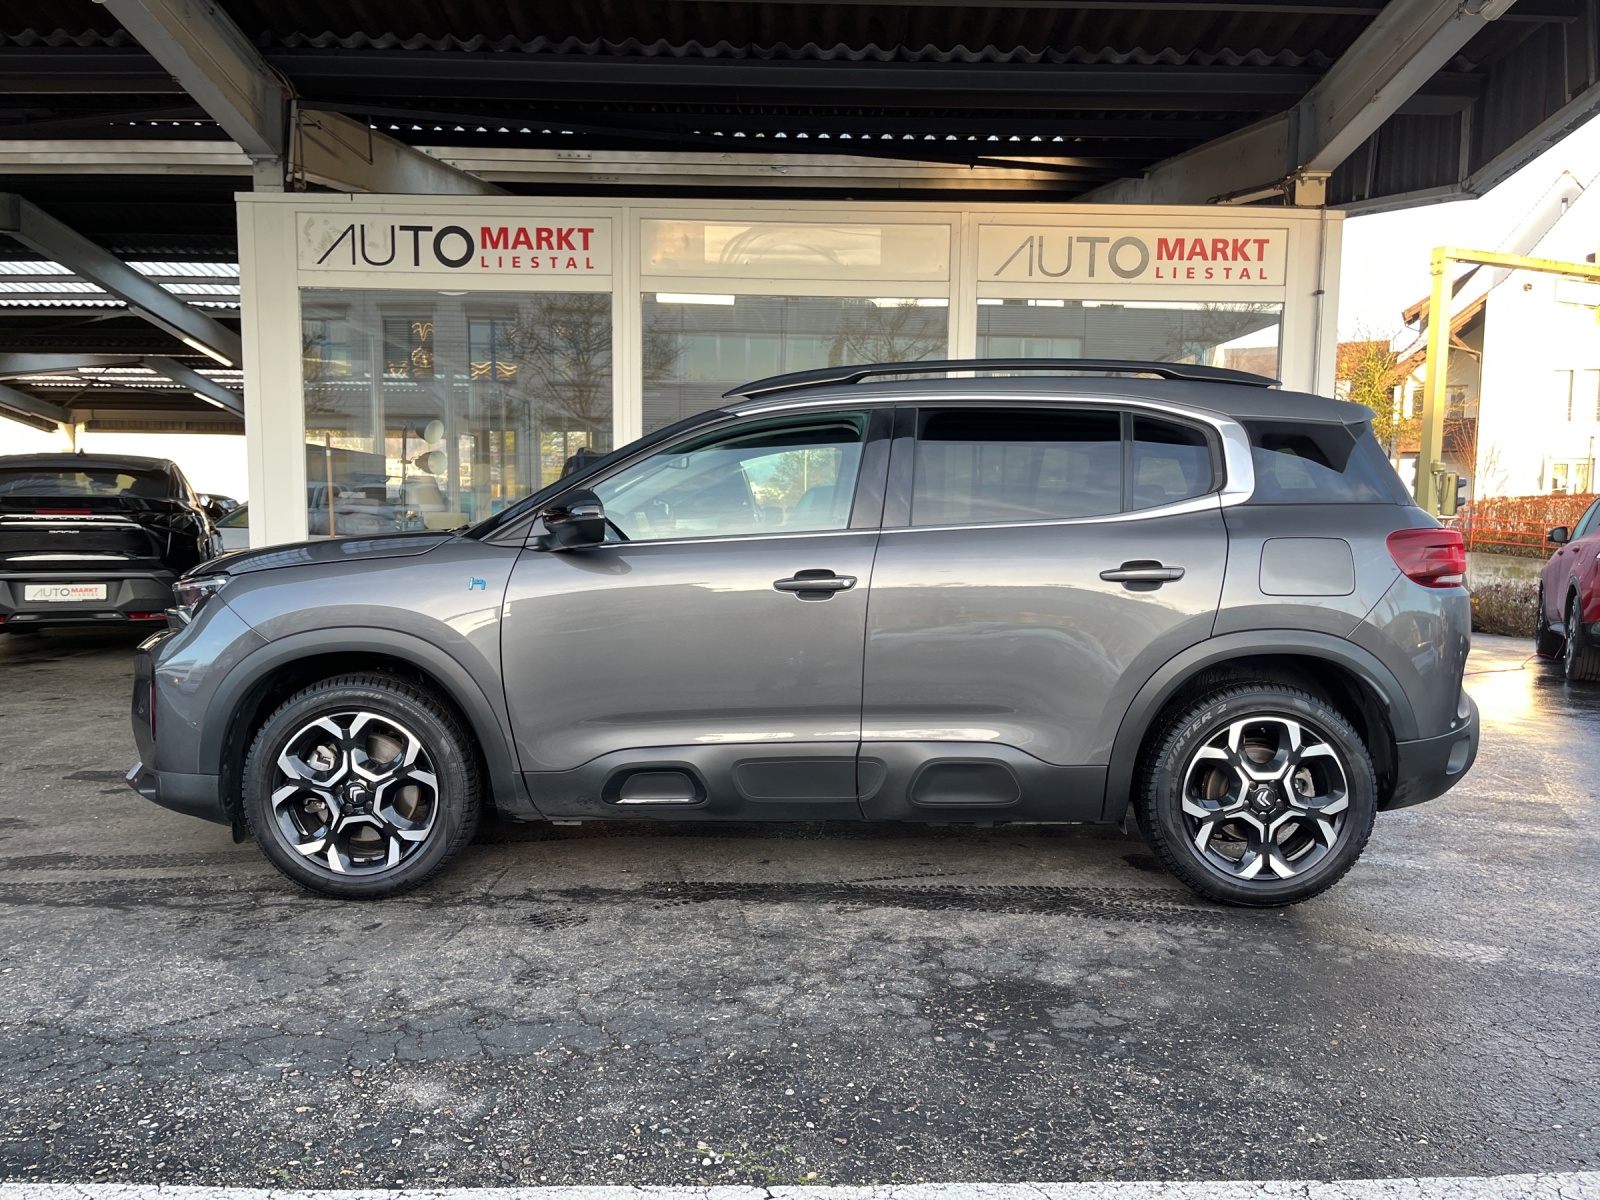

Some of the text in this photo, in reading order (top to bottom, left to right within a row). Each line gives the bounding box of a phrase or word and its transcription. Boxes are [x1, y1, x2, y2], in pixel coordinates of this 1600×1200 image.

[316, 223, 595, 268] AUTO MARKT
[481, 256, 595, 269] LIESTAL
[993, 235, 1270, 279] AUTO MARKT
[1155, 267, 1268, 280] LIESTAL
[1165, 703, 1227, 771] WINTER 2
